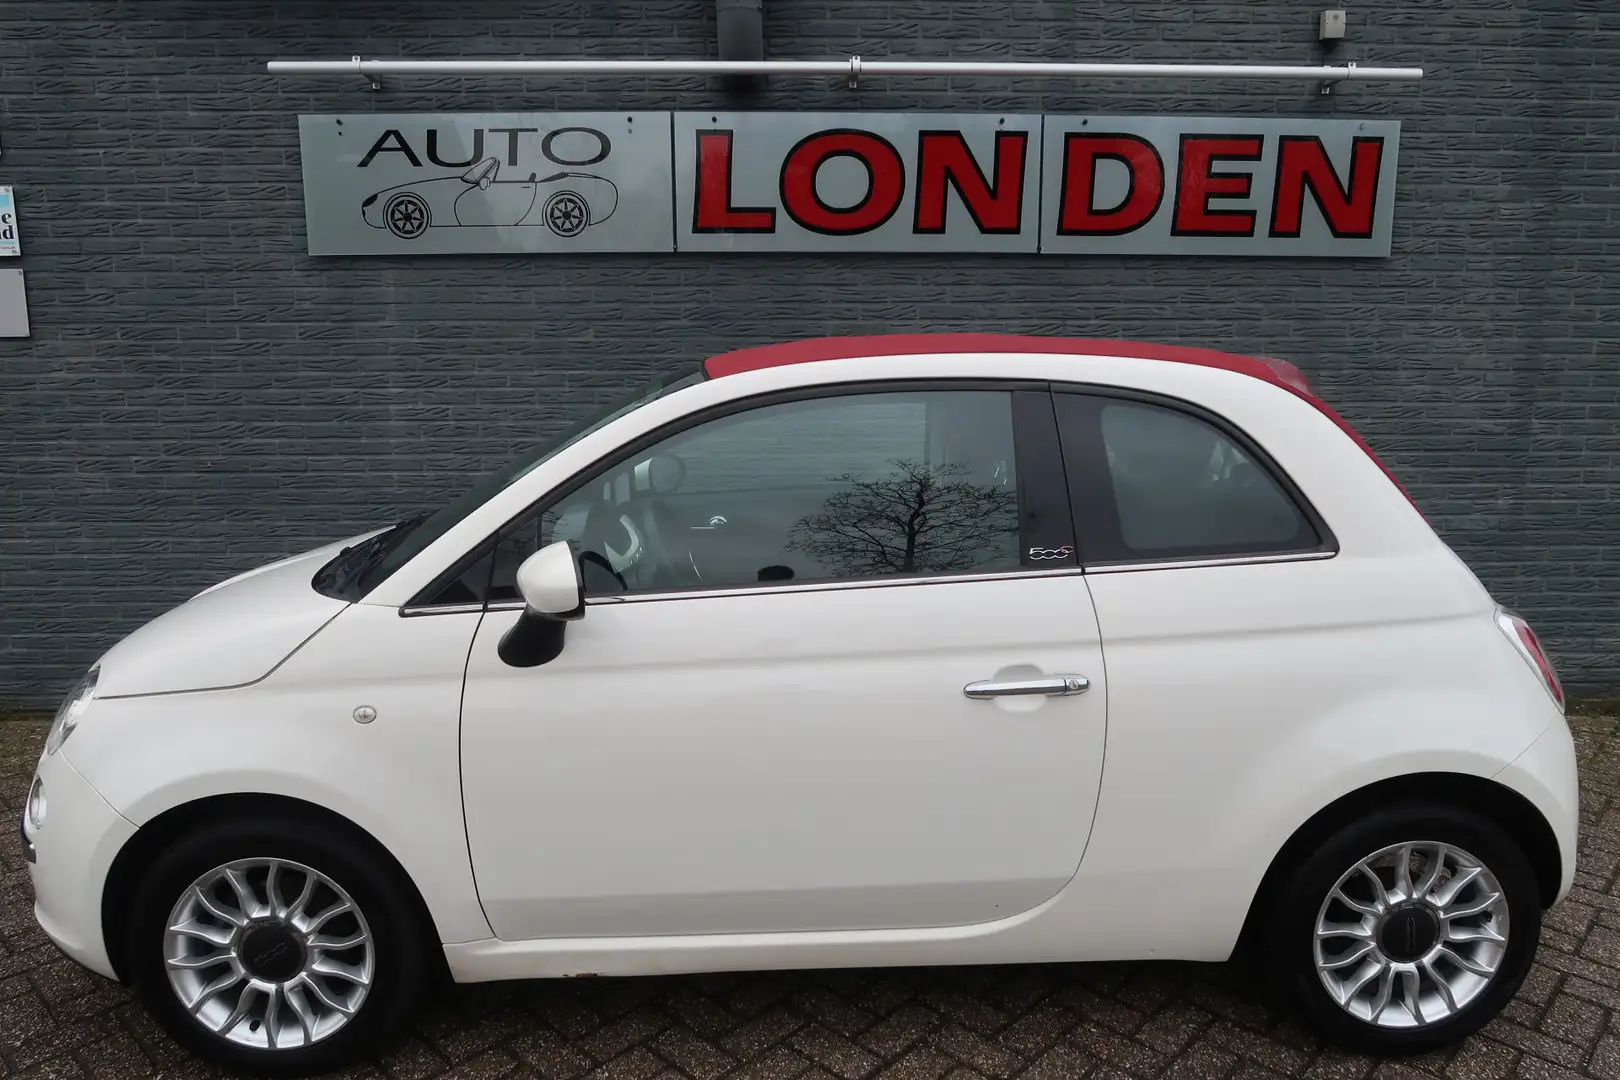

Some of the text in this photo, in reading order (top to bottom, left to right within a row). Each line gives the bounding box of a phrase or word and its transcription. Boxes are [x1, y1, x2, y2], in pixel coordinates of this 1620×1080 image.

[357, 126, 1384, 239] AUTO LONDEN
[0, 225, 14, 239] d
